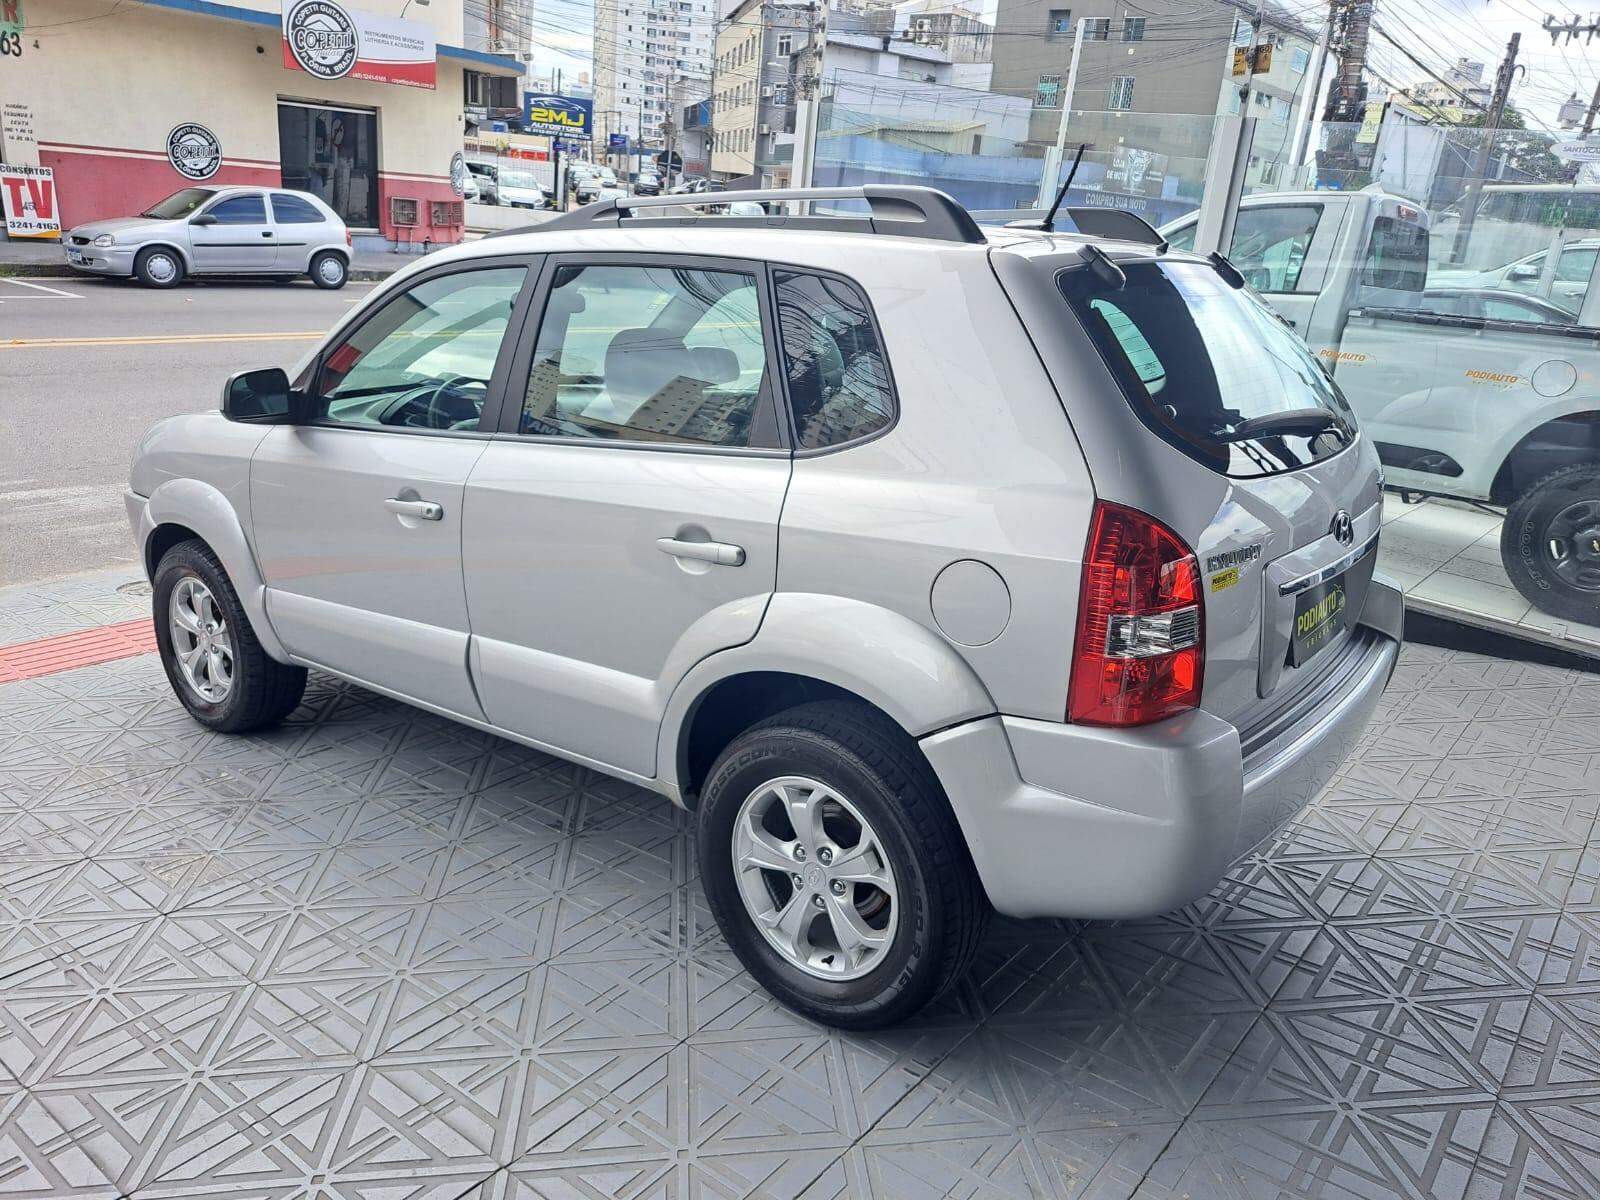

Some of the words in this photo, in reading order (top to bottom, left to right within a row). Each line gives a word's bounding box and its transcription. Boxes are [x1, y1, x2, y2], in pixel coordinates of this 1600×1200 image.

[295, 3, 319, 25] COPETTI
[320, 5, 348, 29] GUITARS
[293, 27, 354, 51] COPETTI
[301, 51, 331, 75] FLORIPA
[333, 51, 353, 73] BRAZIL
[531, 107, 585, 127] 2MJ
[0, 165, 52, 176] CONSERTOS
[2, 177, 53, 219] TV
[1085, 193, 1114, 206] COMPRO
[1115, 196, 1128, 208] SUA
[1129, 198, 1147, 210] MOTO
[9, 221, 59, 231] 3241-4163
[1465, 369, 1518, 384] PODIAUTO
[1297, 590, 1336, 637] PODIAUTO
